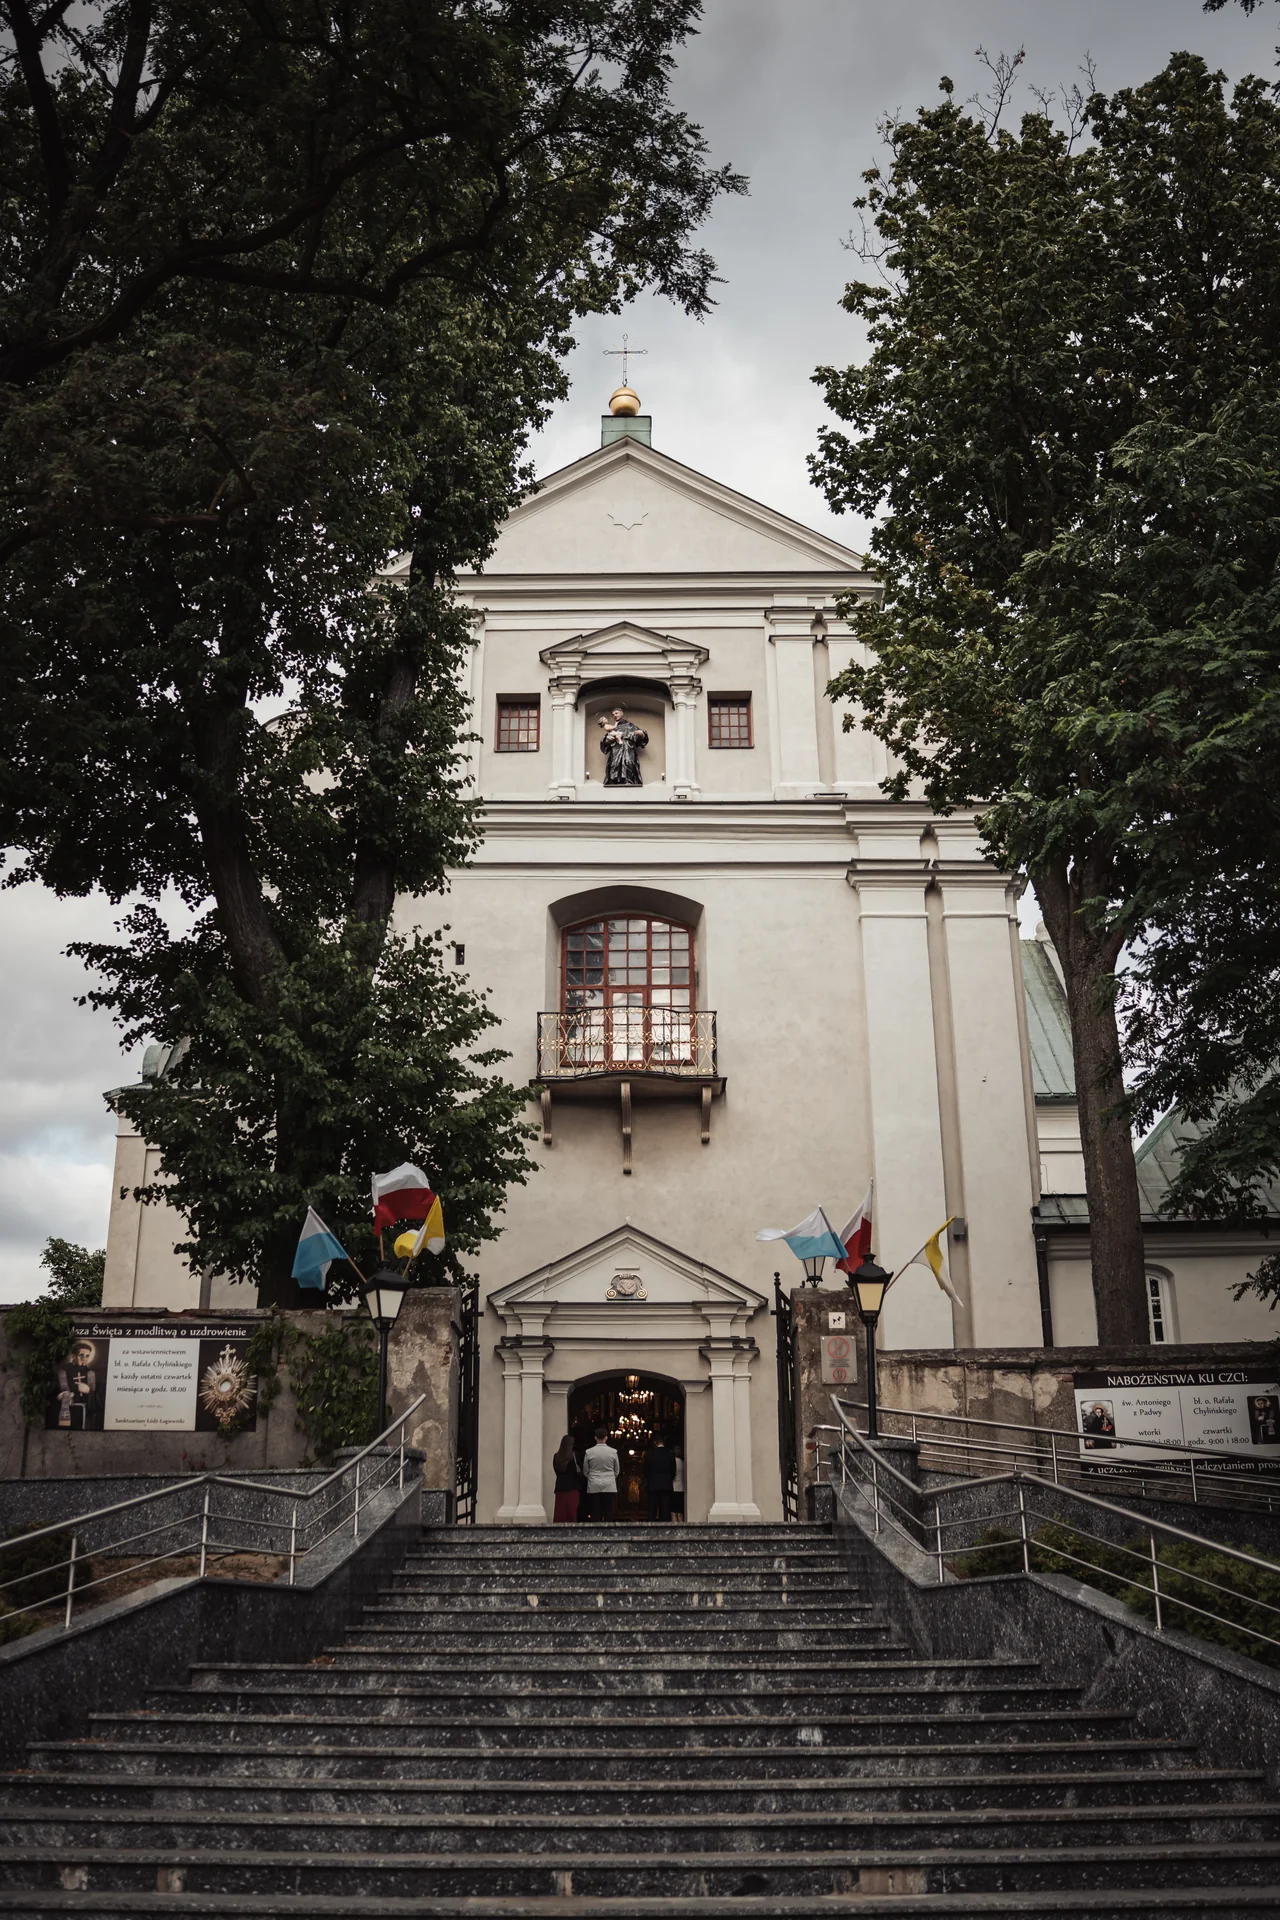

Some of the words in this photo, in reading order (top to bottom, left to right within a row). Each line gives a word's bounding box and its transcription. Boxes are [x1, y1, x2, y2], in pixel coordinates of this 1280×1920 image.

[92, 1324, 122, 1338] Święta
[135, 1326, 177, 1338] modlitwą
[190, 1326, 246, 1336] uzdrowienie
[153, 1361, 192, 1369] Chylińskiego
[1107, 1374, 1195, 1386] NABOŻEŃSTWA
[1198, 1374, 1214, 1383] KU
[1218, 1373, 1248, 1383] CZCI:
[151, 1386, 168, 1394] godz.
[1136, 1399, 1171, 1407] Antoniego
[1140, 1409, 1162, 1417] Padwy
[1194, 1407, 1237, 1416] Chylińskiego
[1188, 1438, 1206, 1447] godz.
[1196, 1461, 1254, 1471] odczytaniem
